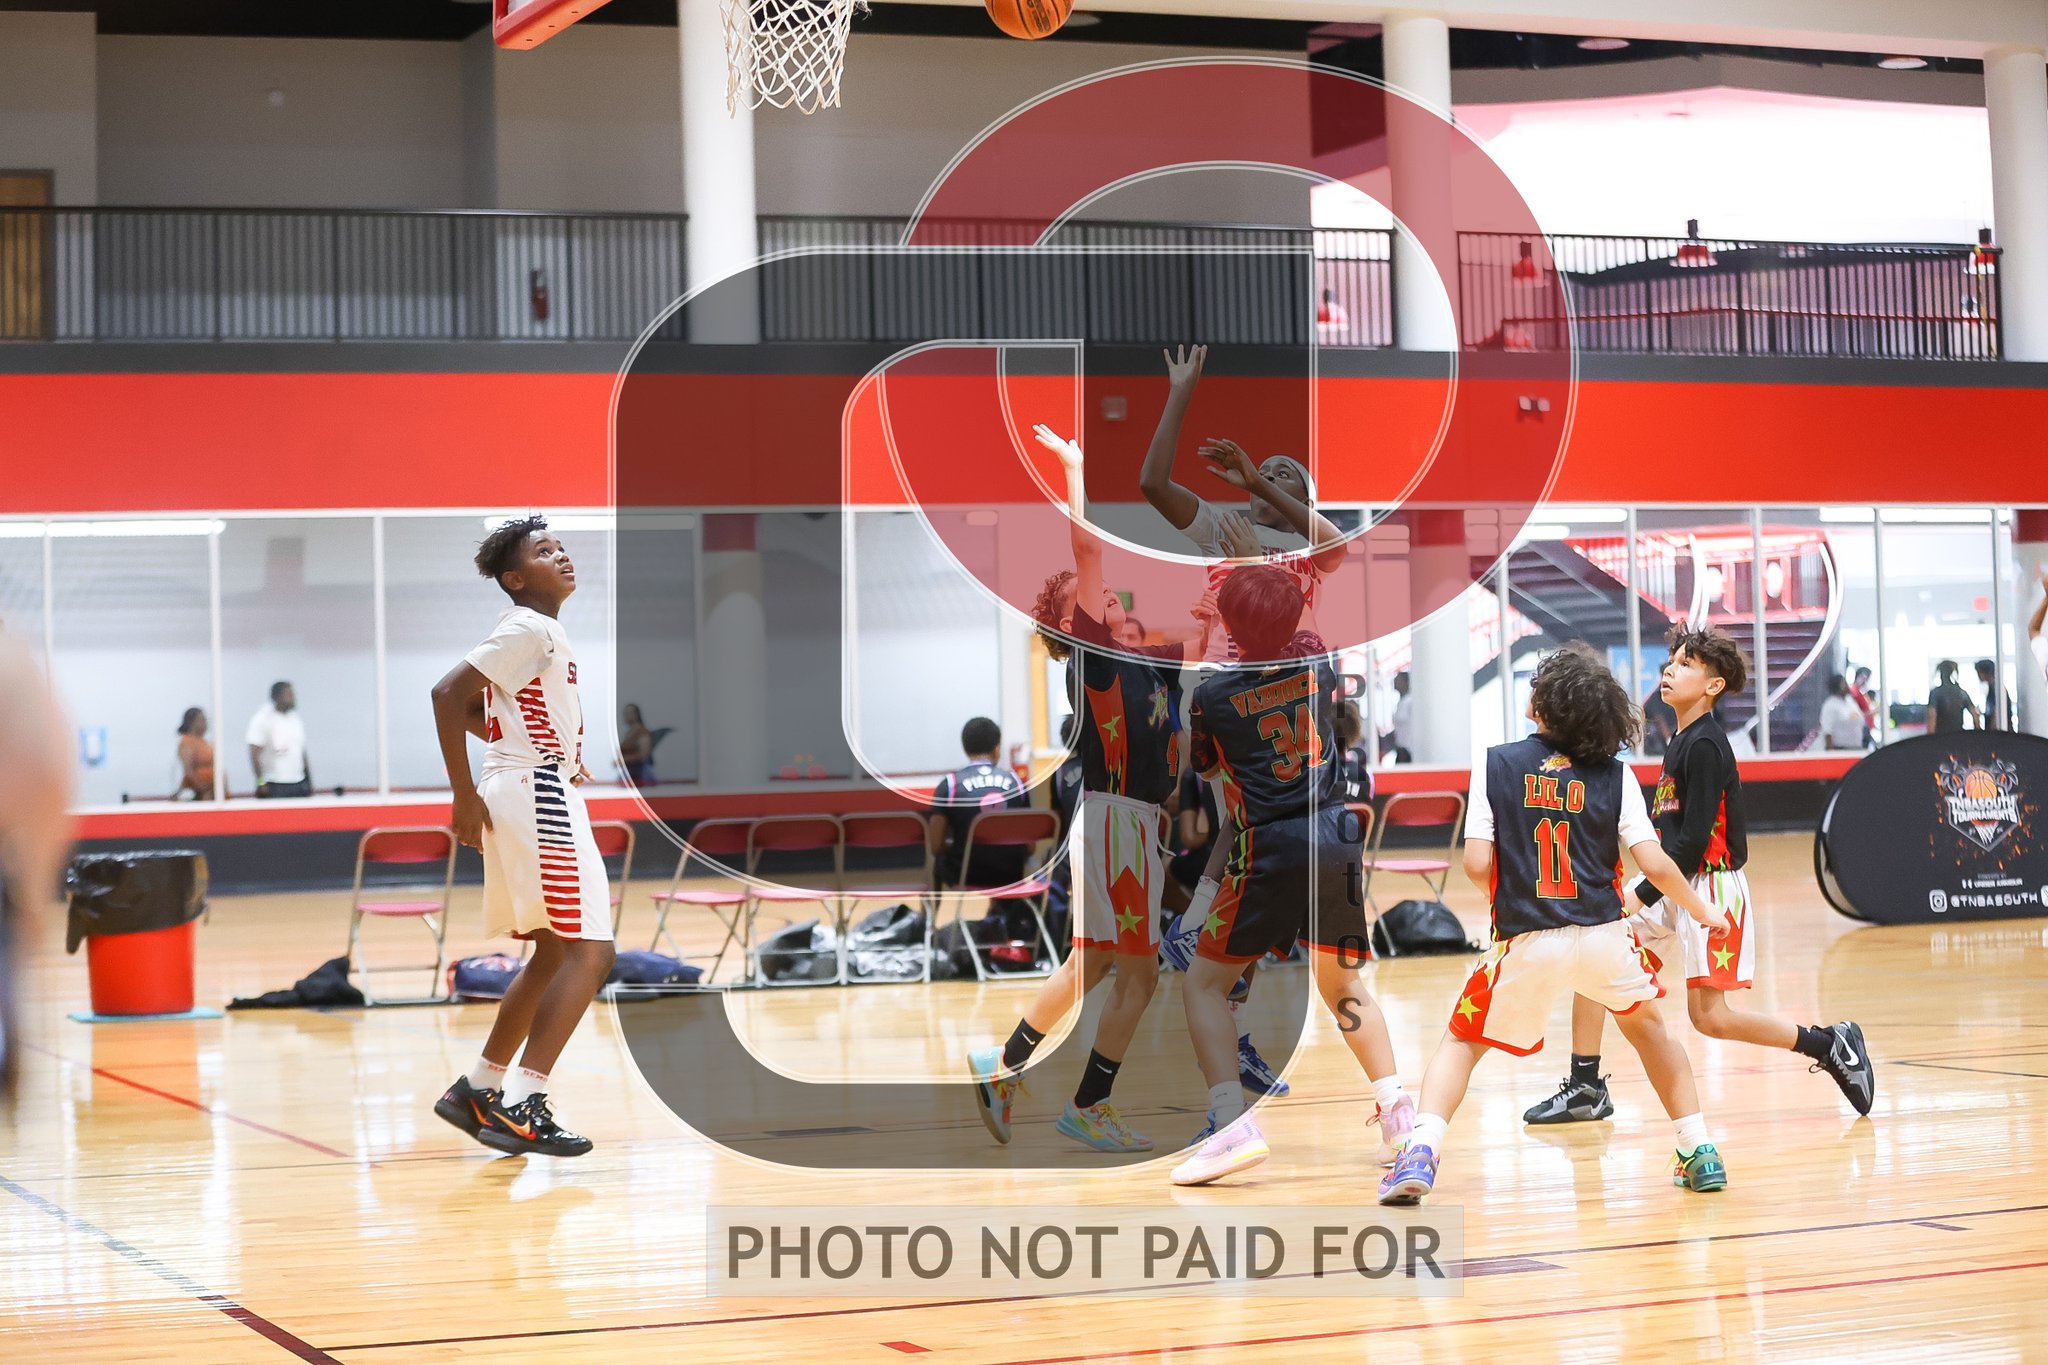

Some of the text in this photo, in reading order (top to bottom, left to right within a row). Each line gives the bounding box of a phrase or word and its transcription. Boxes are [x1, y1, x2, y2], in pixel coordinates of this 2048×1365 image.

[1257, 703, 1327, 782] 34
[1524, 774, 1585, 813] LIL O
[1534, 818, 1577, 899] 11
